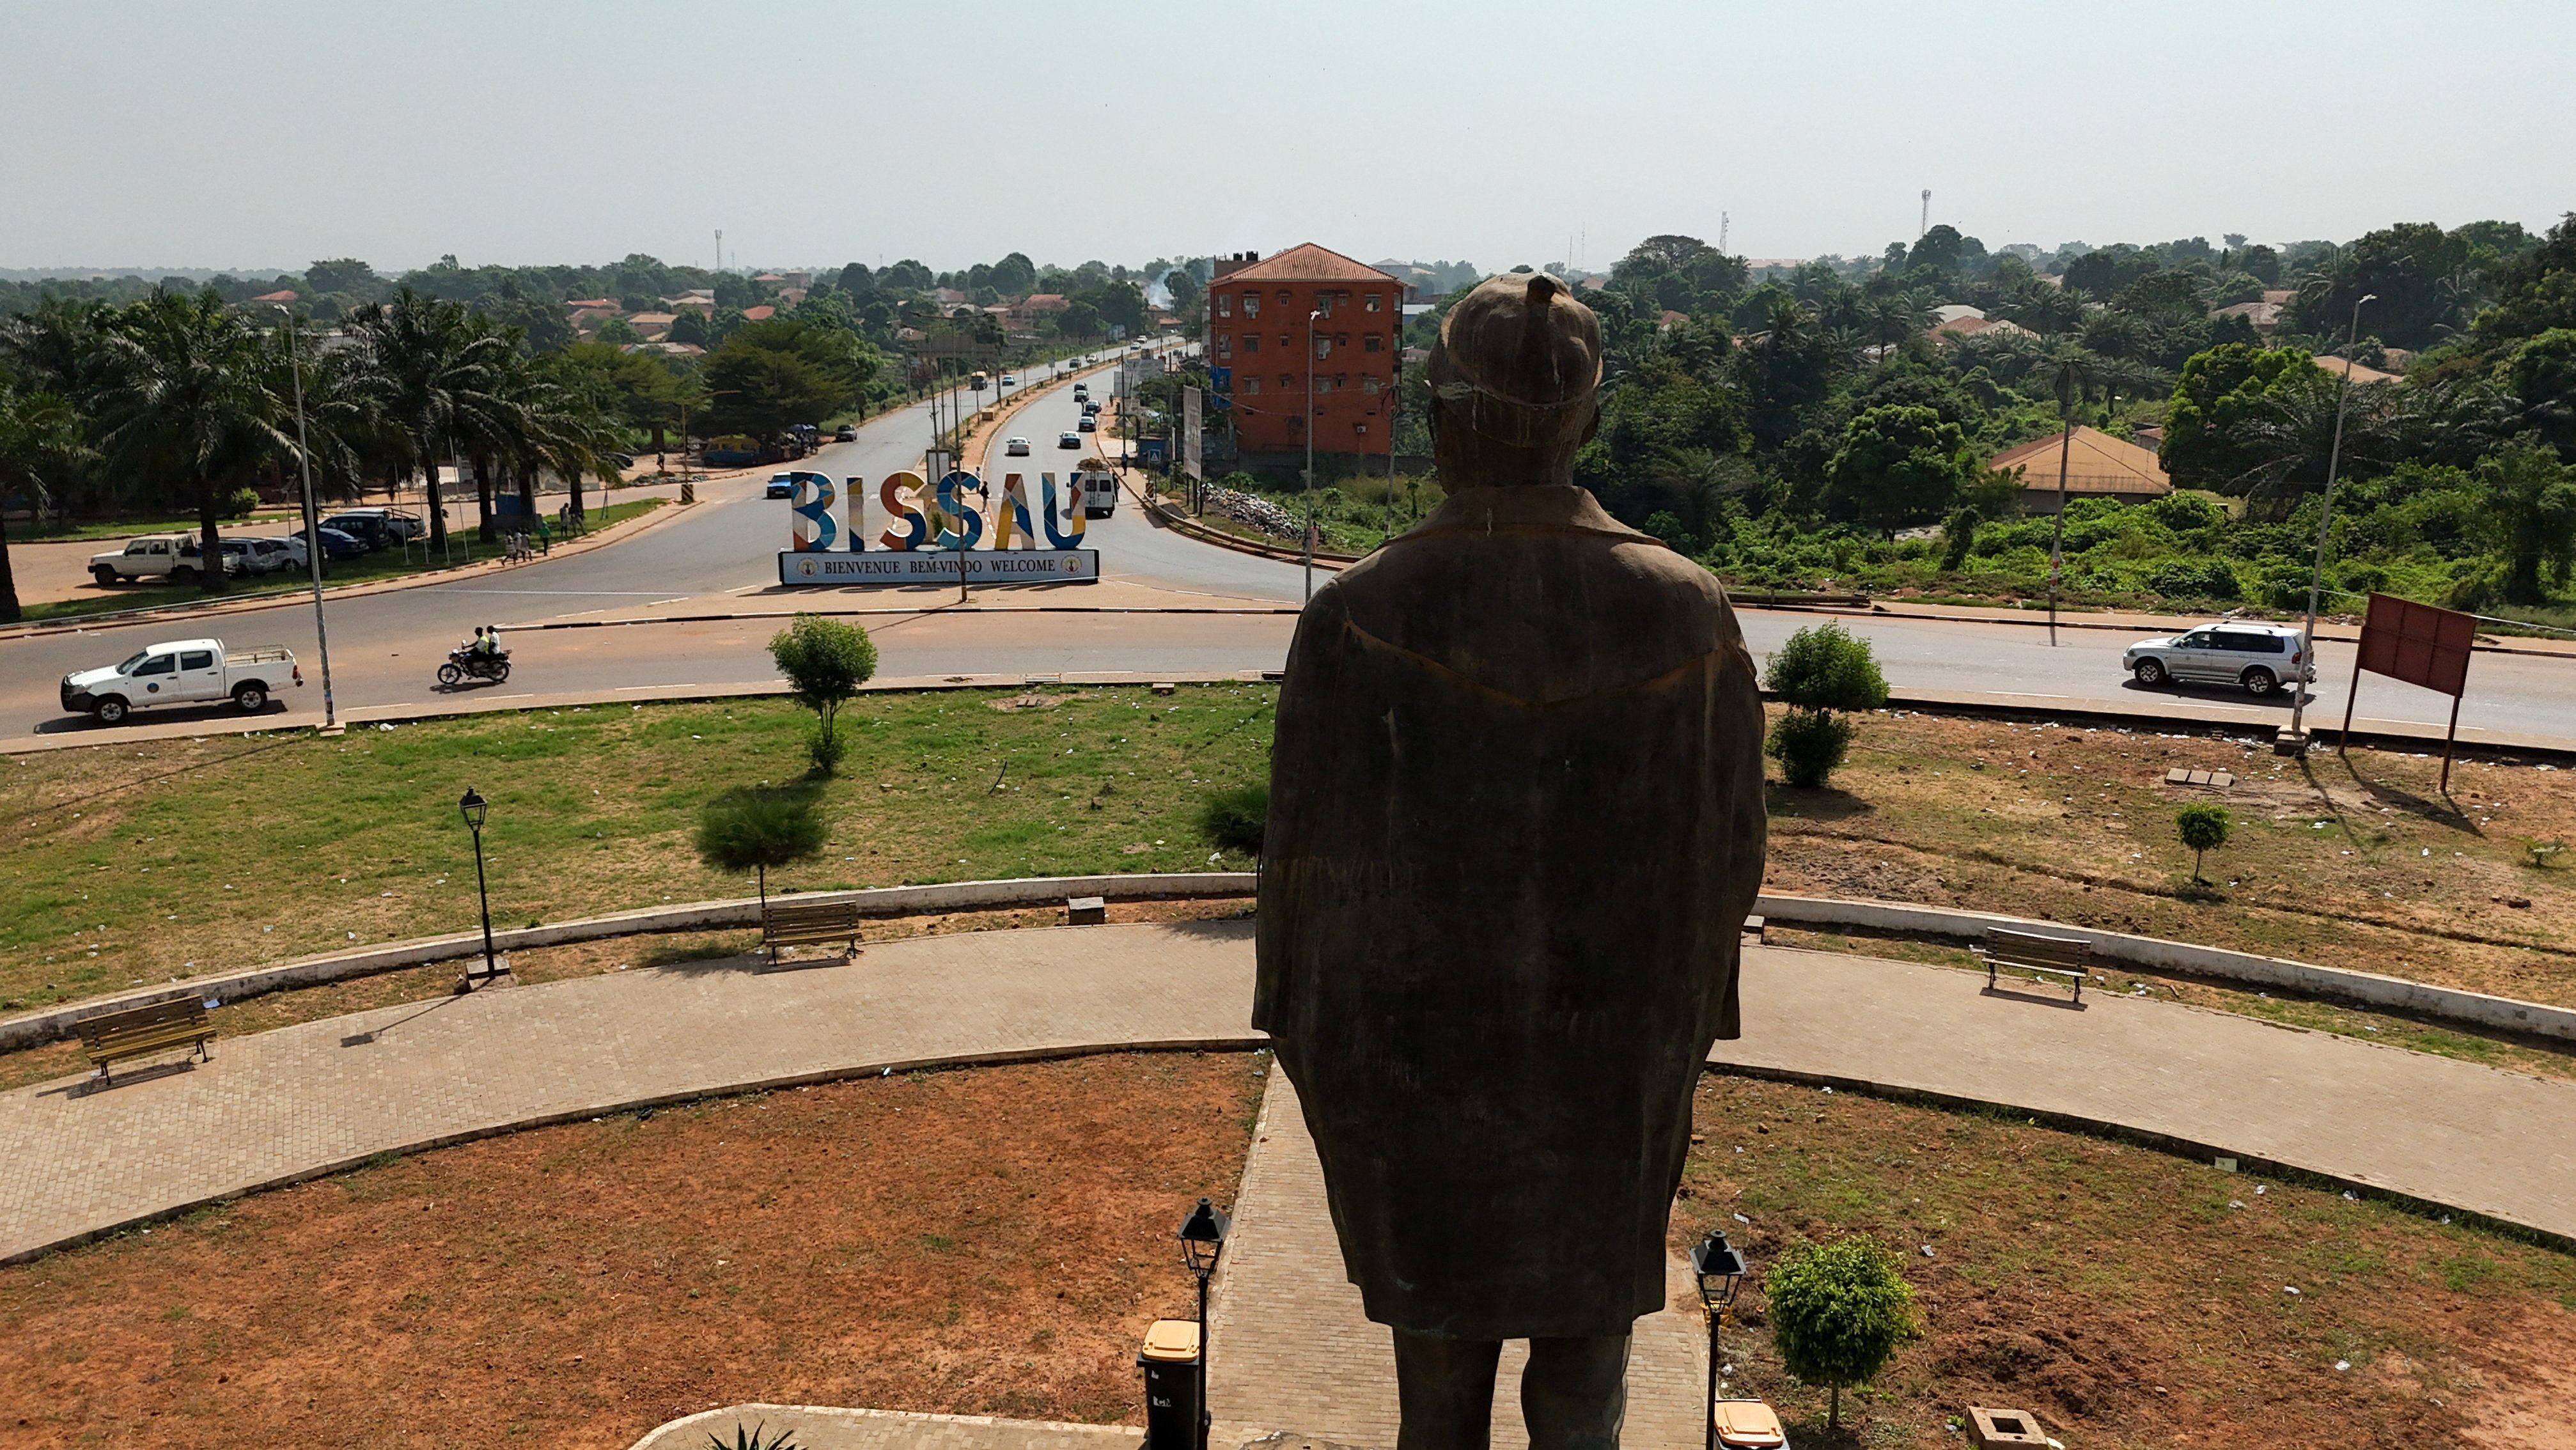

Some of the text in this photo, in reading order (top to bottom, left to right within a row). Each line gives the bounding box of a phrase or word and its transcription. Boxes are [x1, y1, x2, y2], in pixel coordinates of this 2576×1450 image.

[790, 470, 1086, 551] BISSAU
[824, 561, 901, 573] BIENVENUE
[990, 559, 1055, 572] WELCOME
